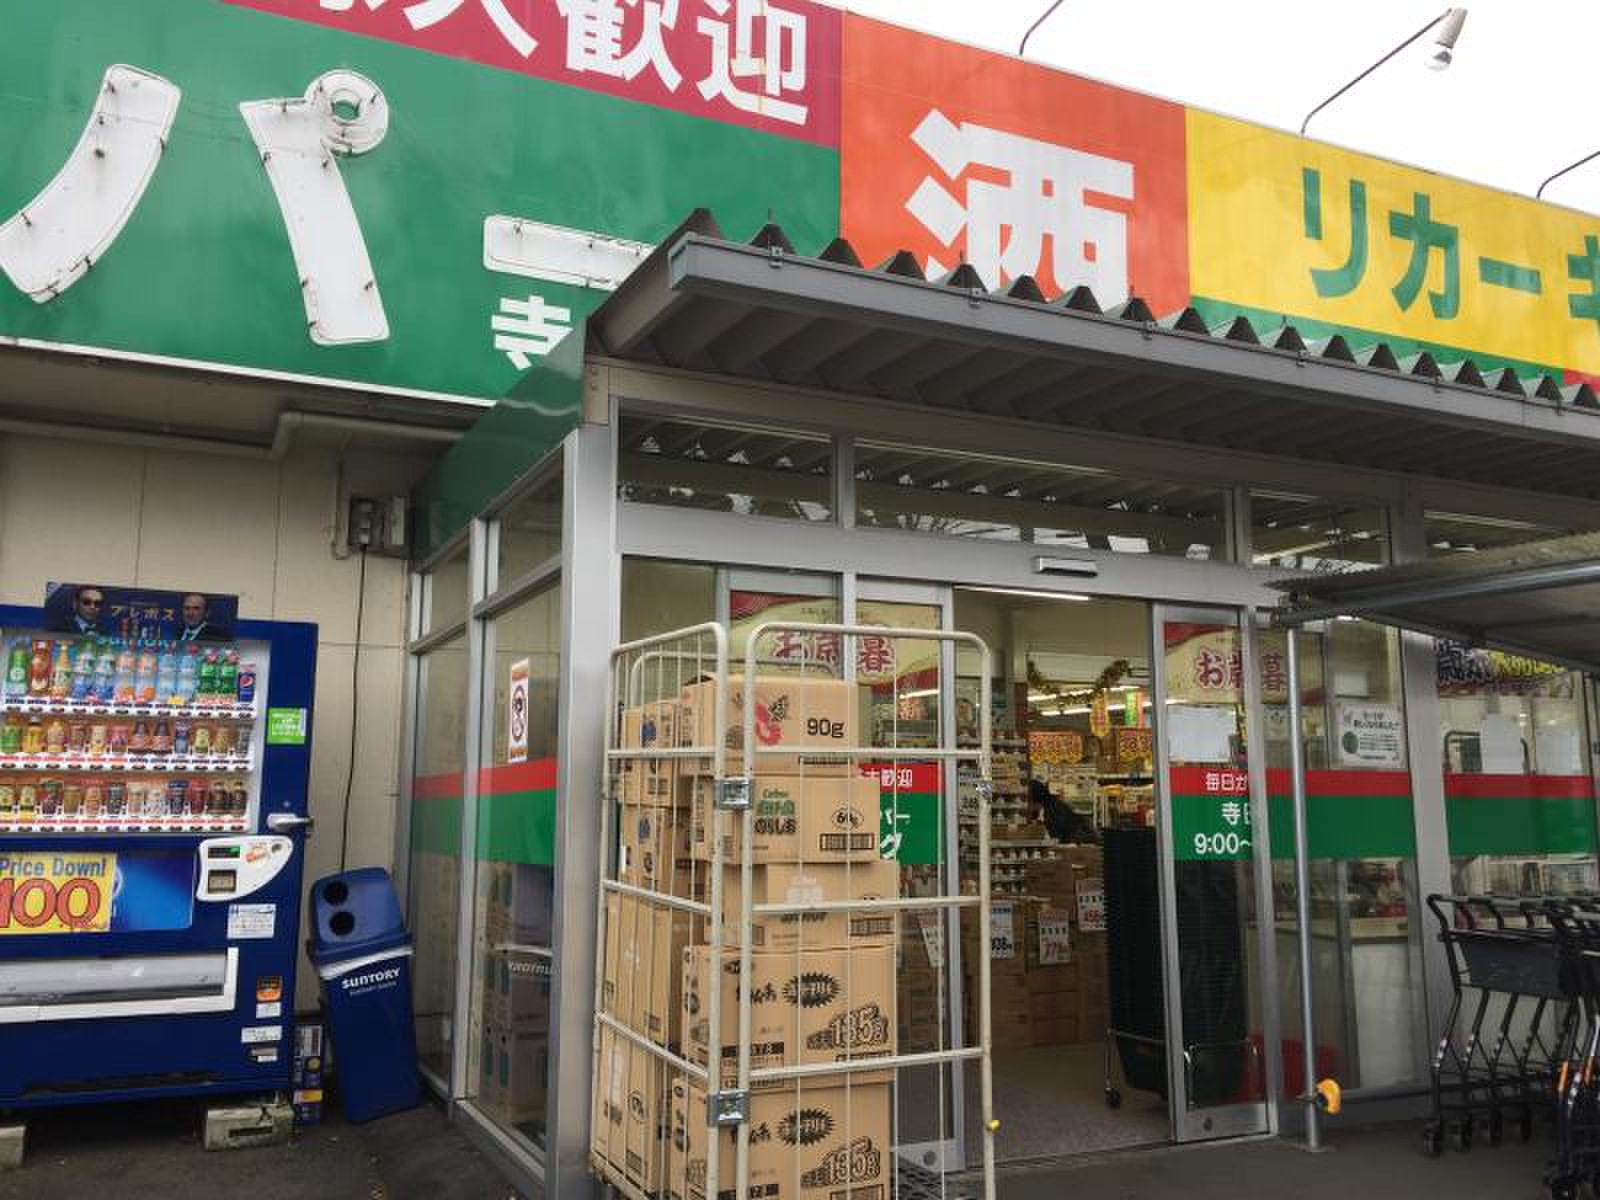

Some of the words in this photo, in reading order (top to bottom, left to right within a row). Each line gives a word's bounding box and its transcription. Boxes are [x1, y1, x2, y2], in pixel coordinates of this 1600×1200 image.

[904, 108, 1135, 312] 酒
[807, 717, 845, 738] 90g
[53, 856, 107, 877] Down!
[341, 966, 401, 990] SUNTORY
